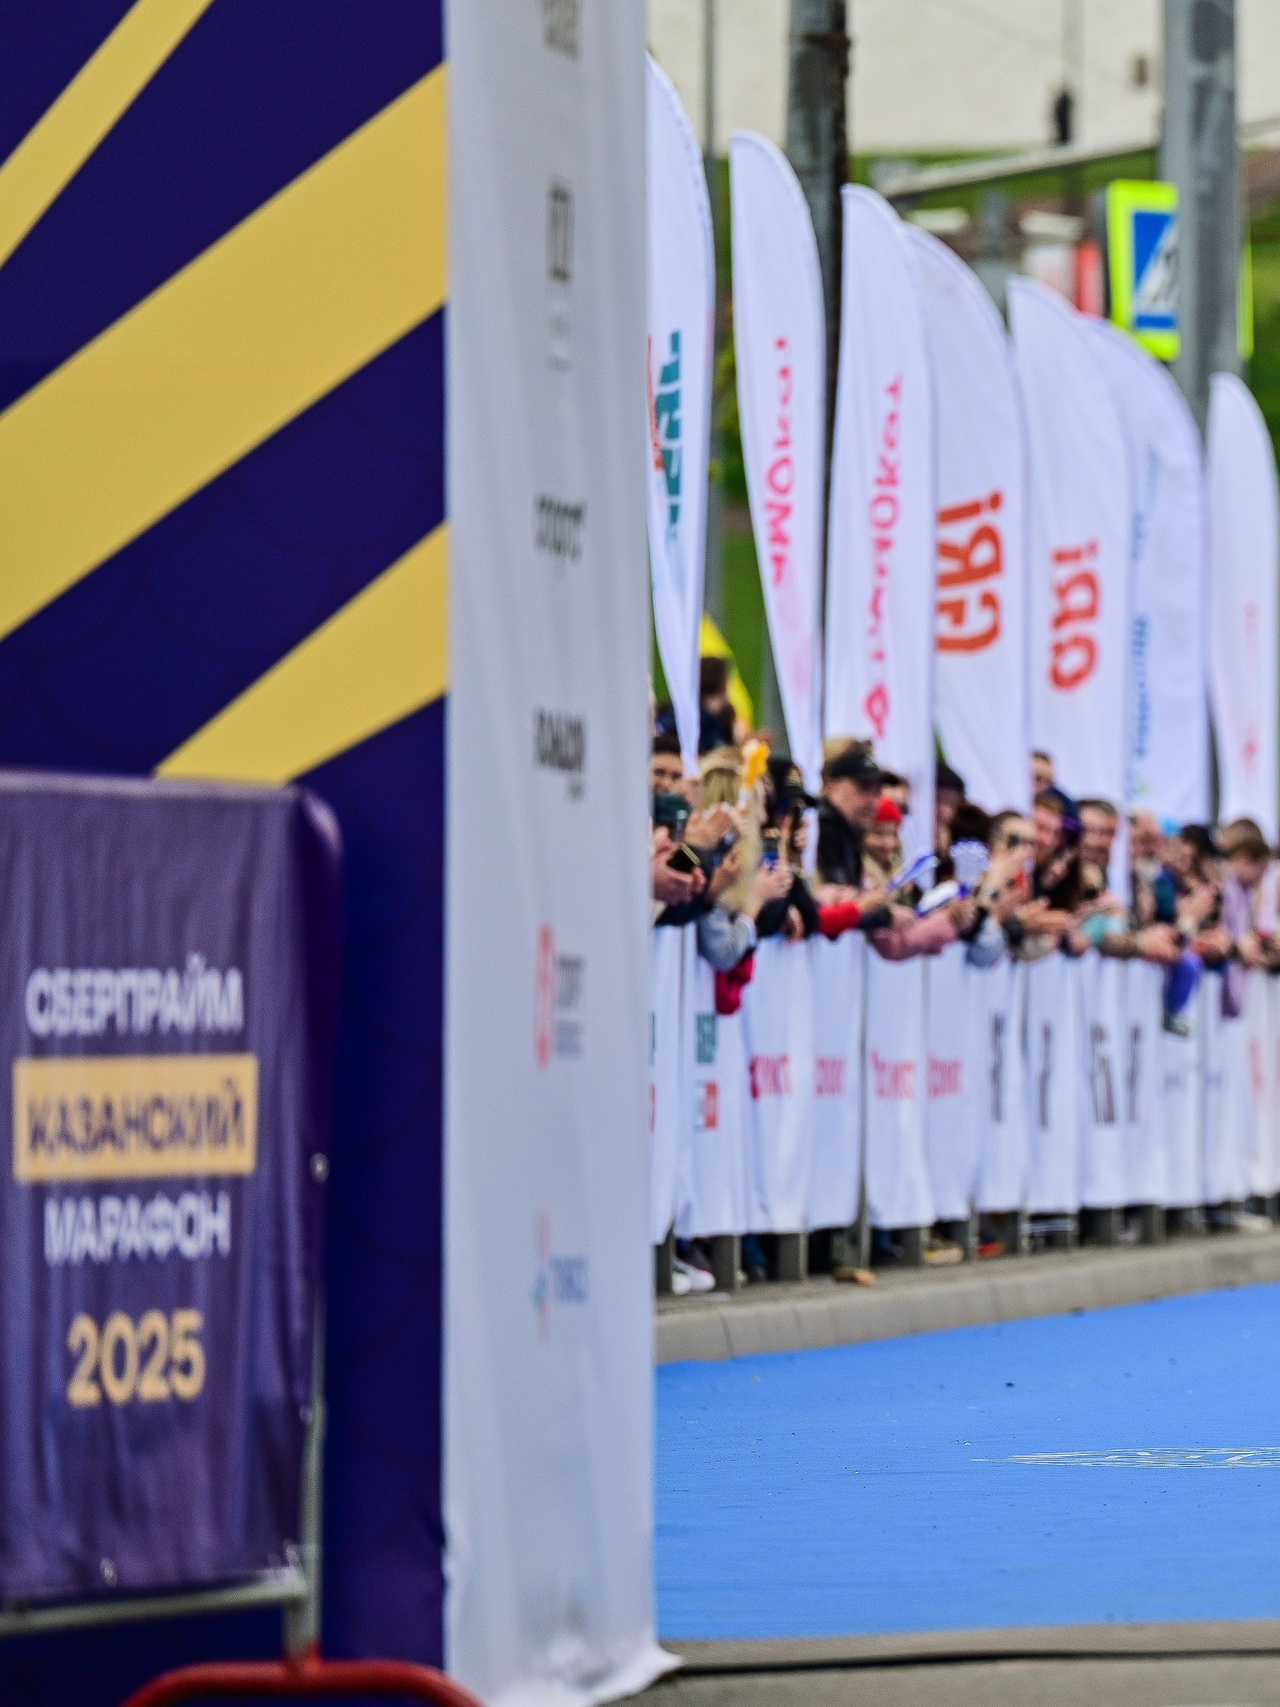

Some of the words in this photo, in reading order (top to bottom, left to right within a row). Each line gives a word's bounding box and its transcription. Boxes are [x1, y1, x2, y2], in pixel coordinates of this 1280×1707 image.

[26, 952, 244, 1036] СБЕРПРАЙМ
[27, 1077, 245, 1153] КАЗАНСКИЙ
[45, 1190, 231, 1264] МАРАФОН
[67, 1309, 205, 1408] 2025
